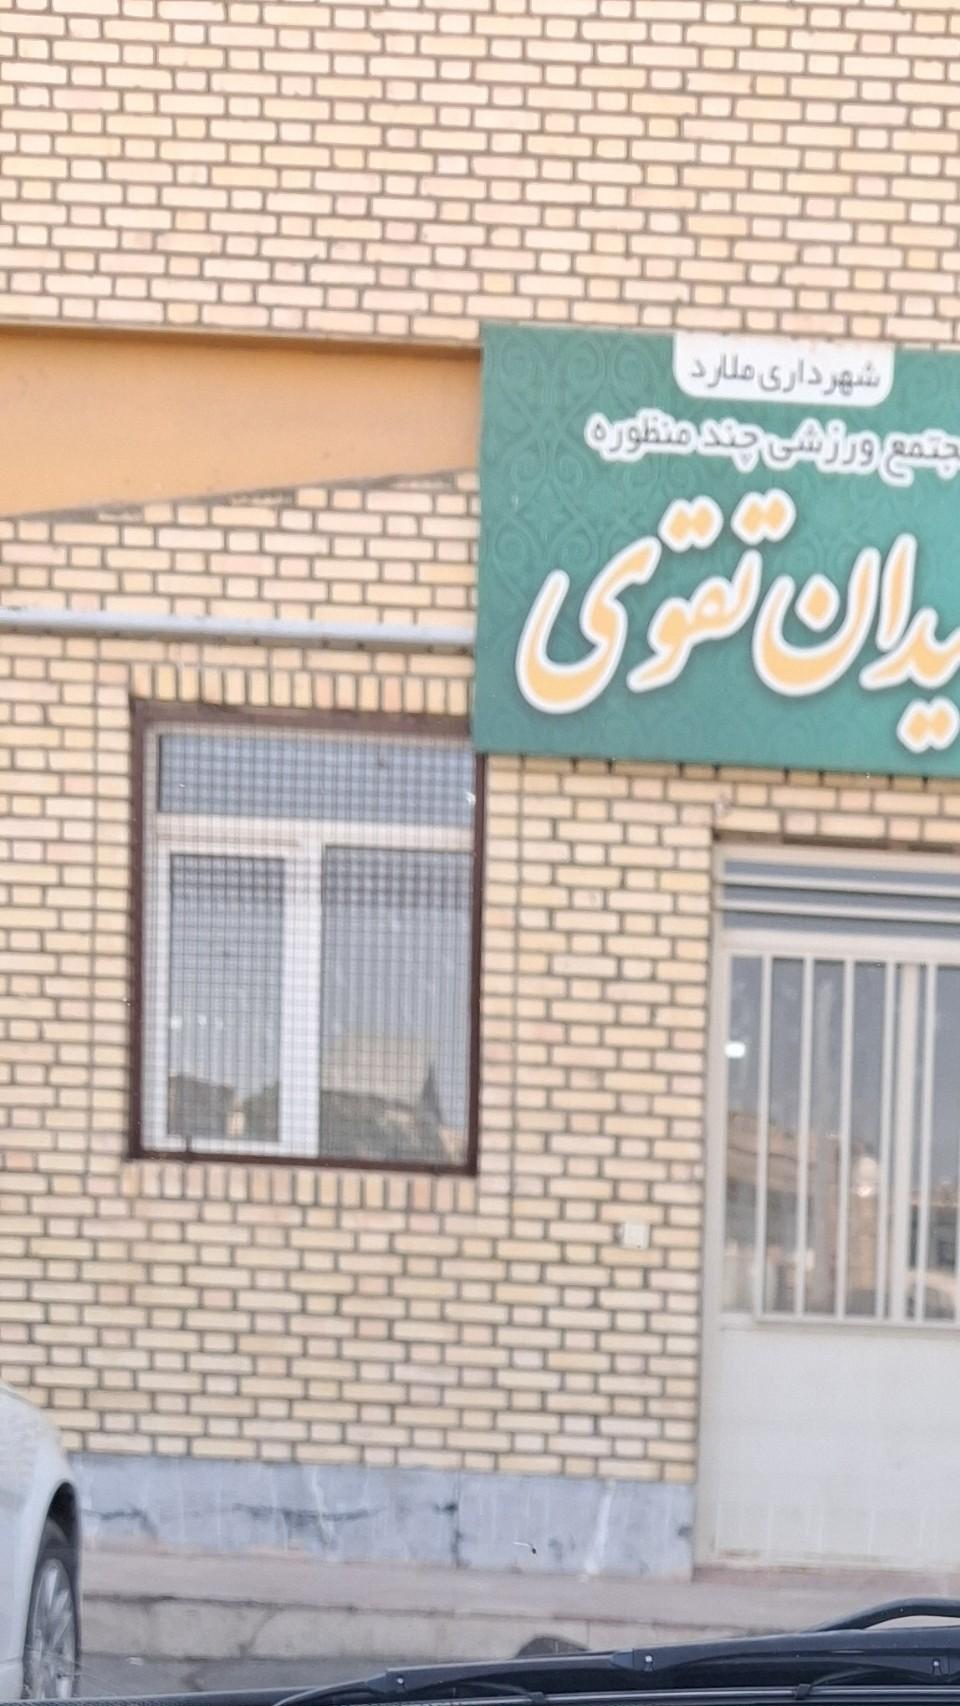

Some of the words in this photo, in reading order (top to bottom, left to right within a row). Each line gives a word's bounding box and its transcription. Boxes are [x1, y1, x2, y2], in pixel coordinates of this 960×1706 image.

[690, 353, 756, 389] ملارد
[757, 358, 881, 397] شهرداری
[587, 413, 692, 456] منظوره
[702, 421, 760, 466] چند
[767, 421, 875, 467] ورزشی
[516, 489, 796, 714] تقوی
